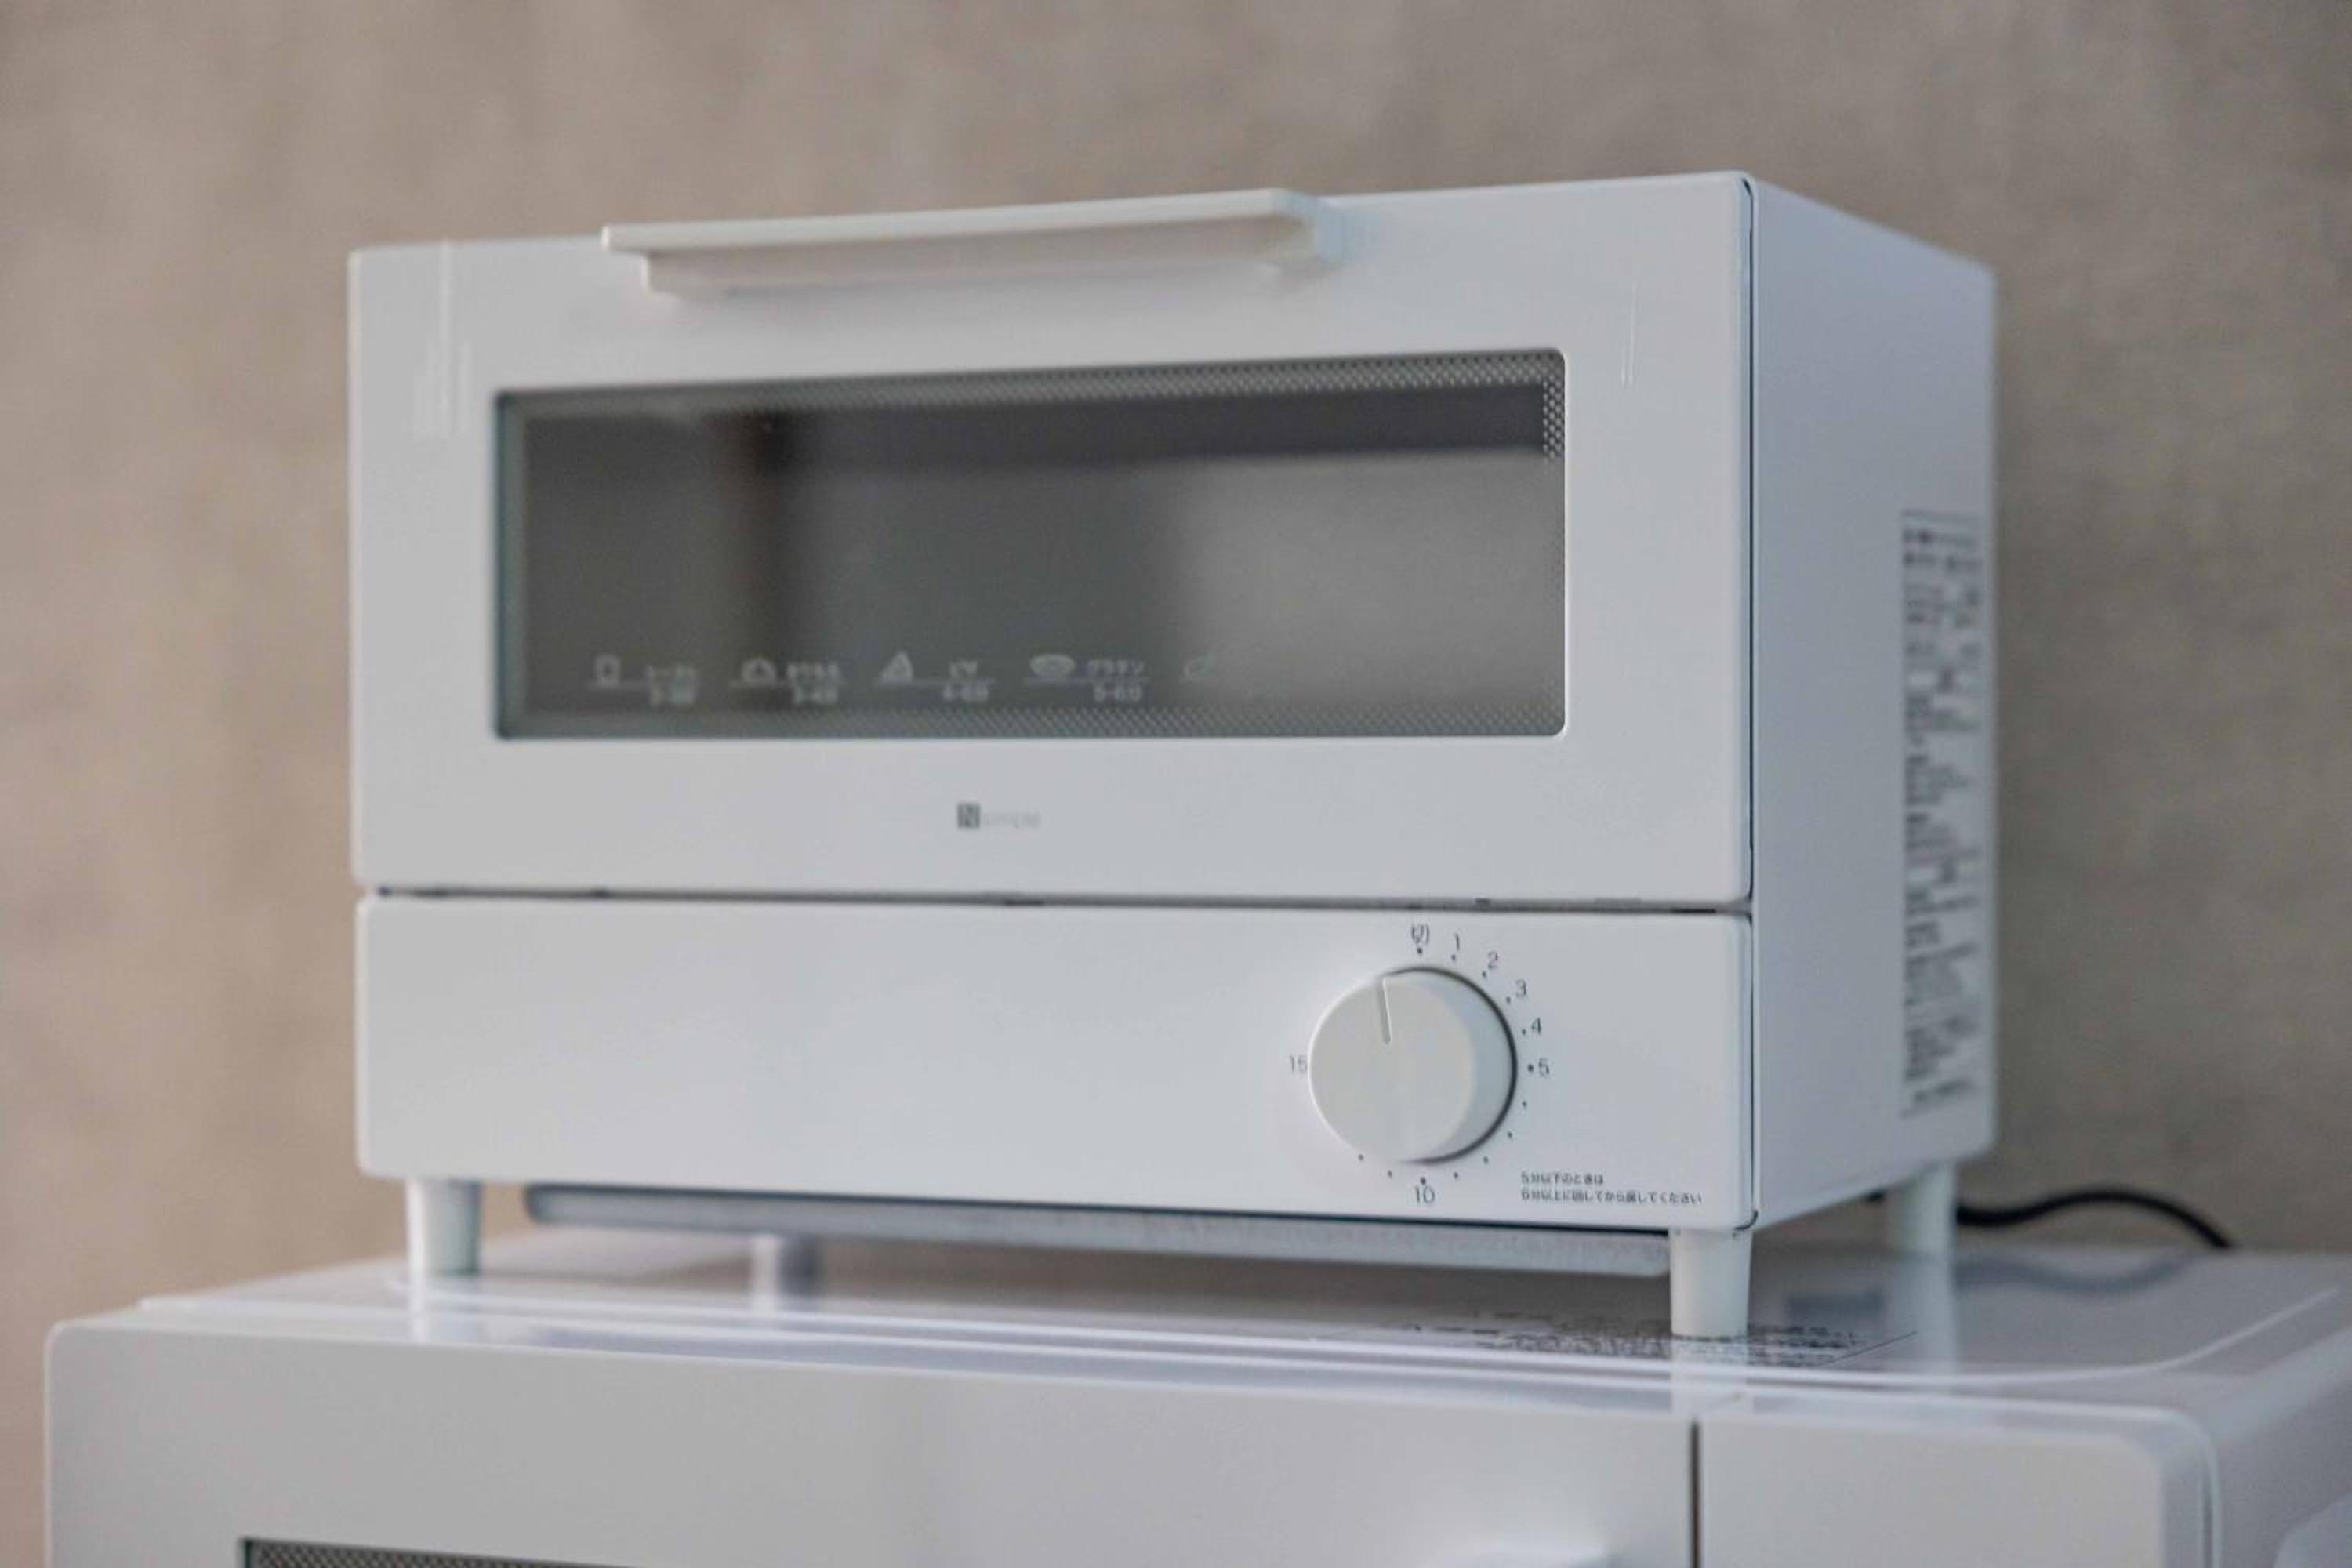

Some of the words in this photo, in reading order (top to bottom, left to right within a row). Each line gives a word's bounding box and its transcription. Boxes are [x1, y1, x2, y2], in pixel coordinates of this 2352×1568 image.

[1411, 924, 1430, 945] 切
[1453, 934, 1461, 950] 1
[1487, 952, 1499, 969] 2
[1515, 982, 1527, 998] 3
[1531, 1018, 1542, 1034] 4
[1289, 1055, 1308, 1073] 15
[1538, 1059, 1550, 1076] 5
[1414, 1186, 1436, 1204] 10
